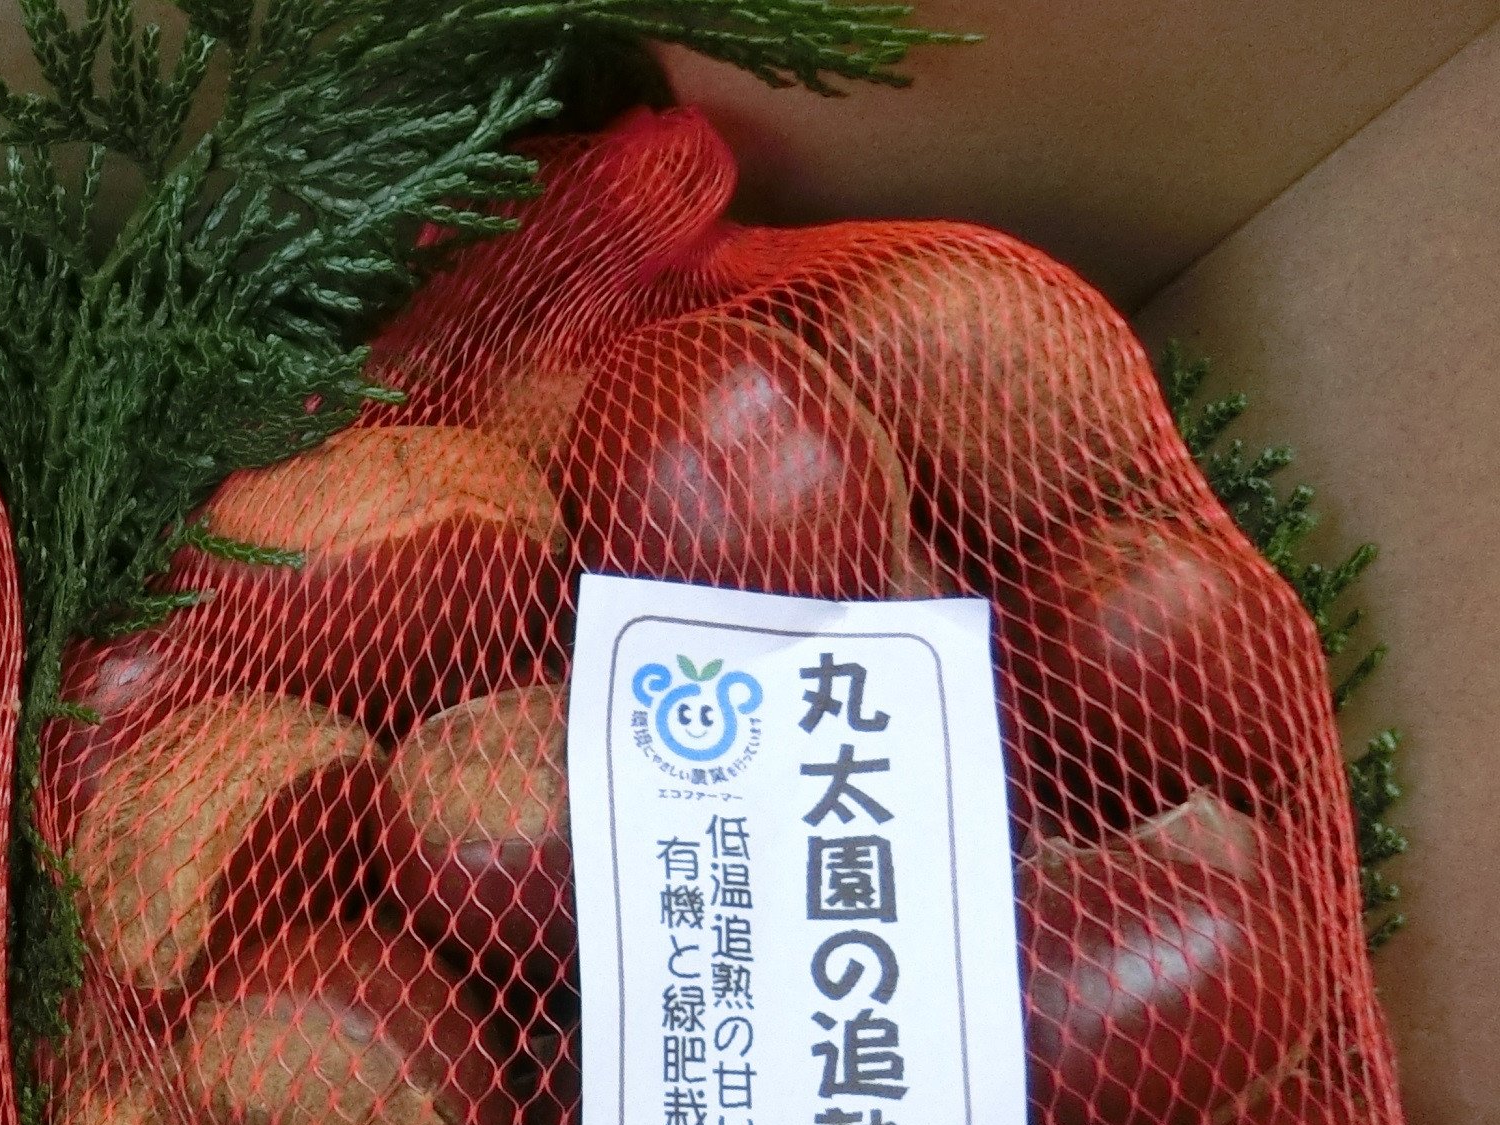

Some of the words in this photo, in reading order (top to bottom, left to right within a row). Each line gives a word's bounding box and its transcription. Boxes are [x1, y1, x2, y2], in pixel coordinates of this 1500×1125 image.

[657, 788, 744, 802] エコファーマー
